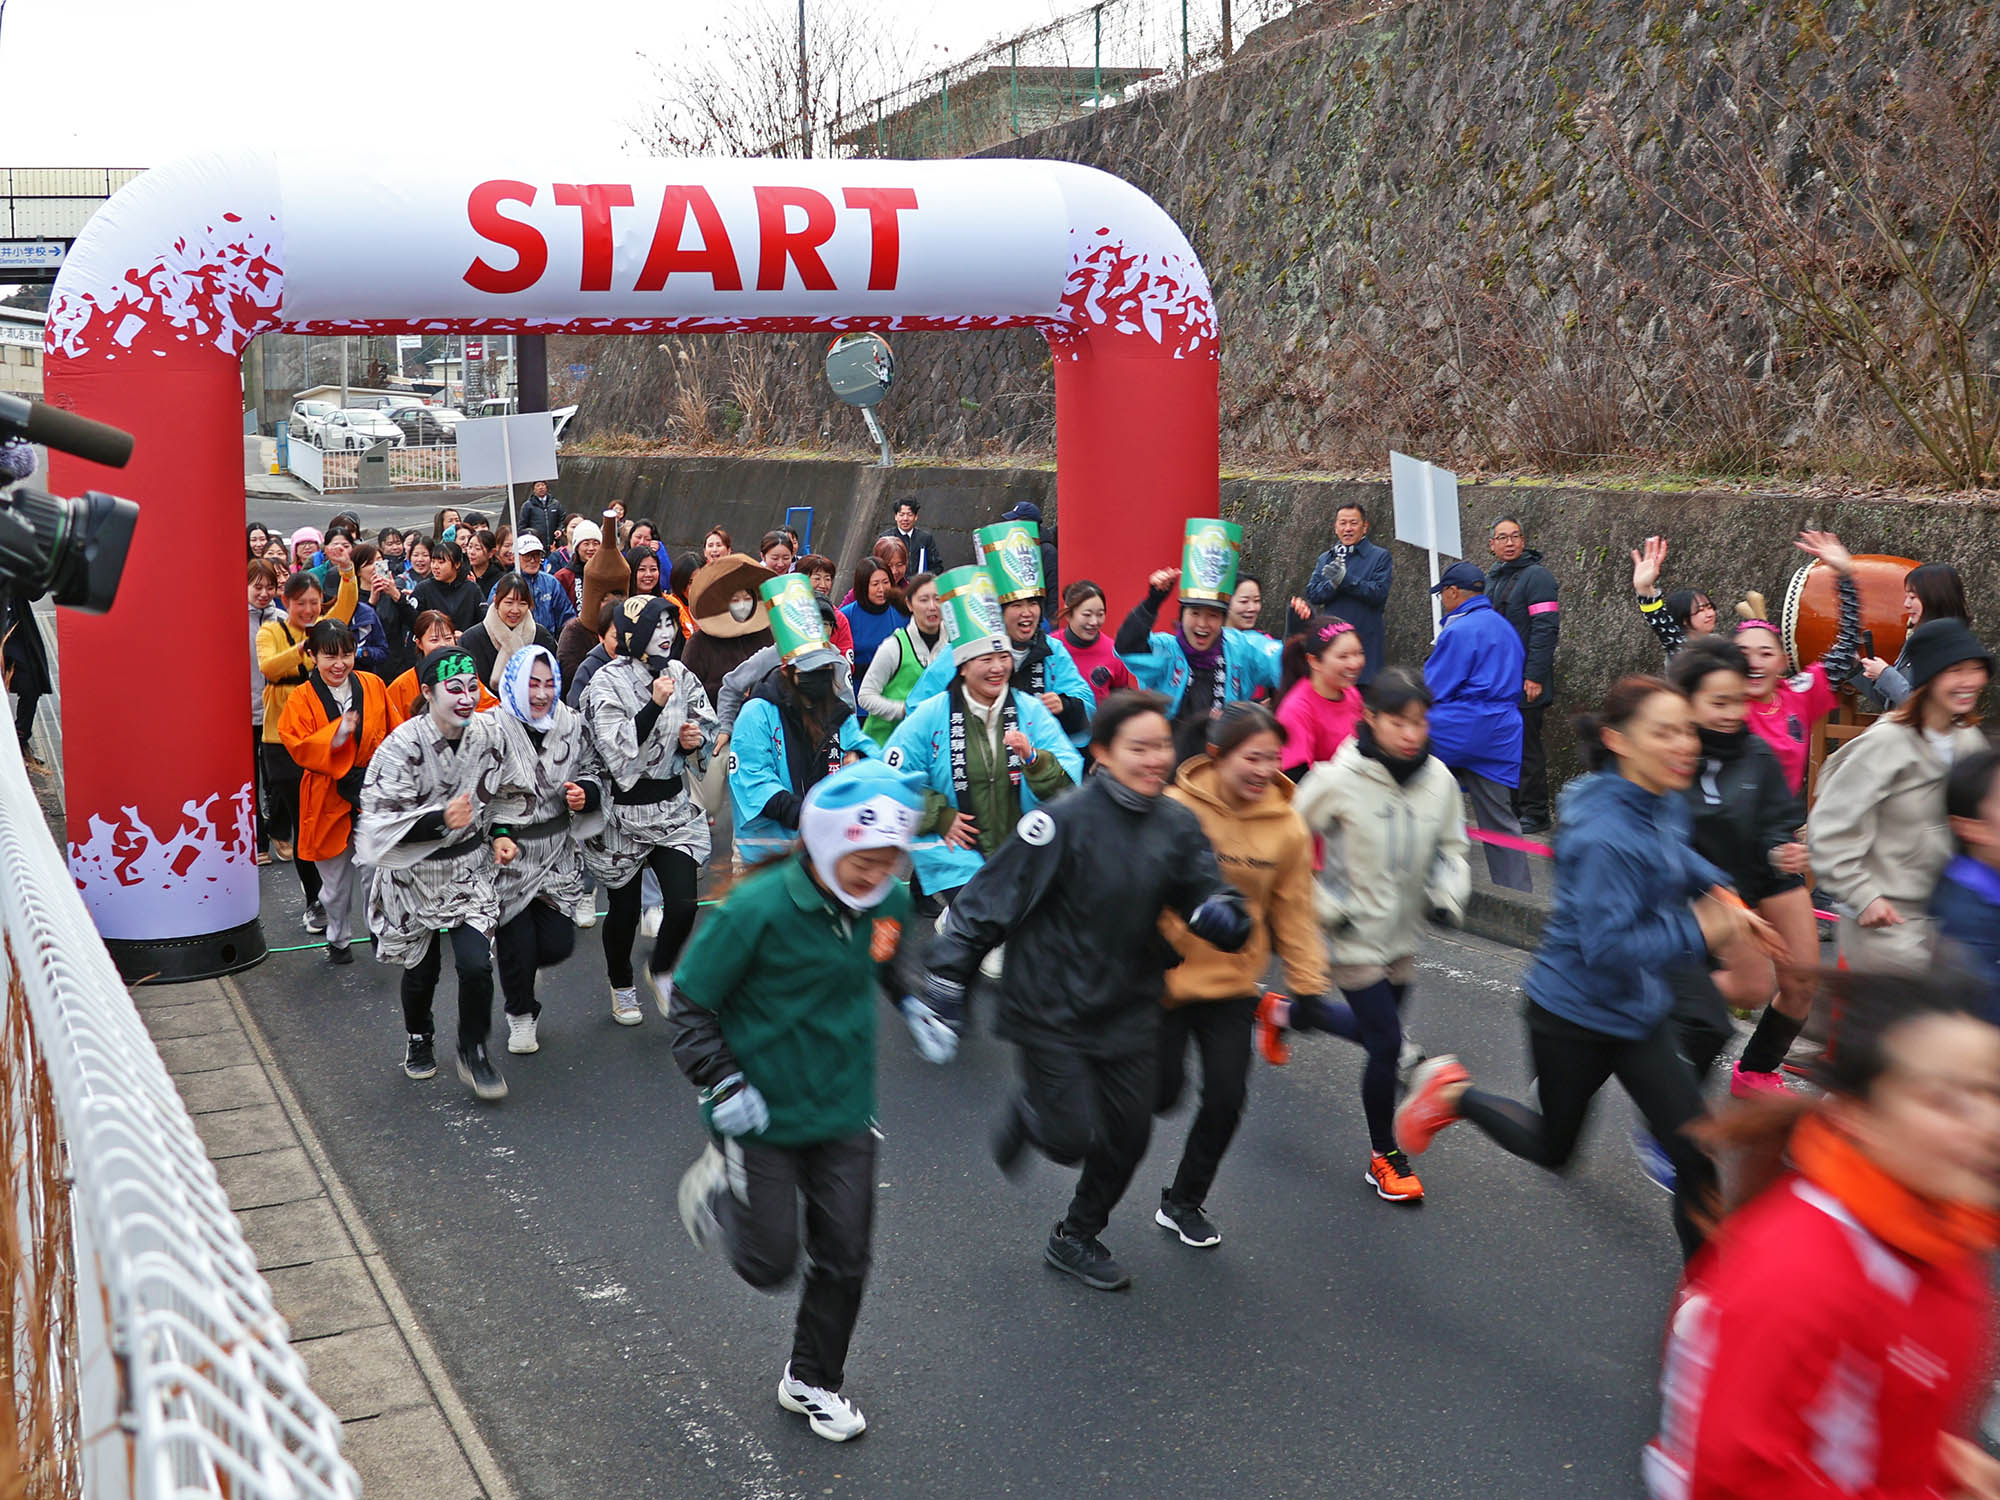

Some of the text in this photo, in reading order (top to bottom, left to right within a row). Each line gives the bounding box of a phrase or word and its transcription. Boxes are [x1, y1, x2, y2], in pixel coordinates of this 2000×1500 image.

[462, 179, 919, 294] START
[729, 756, 737, 769] B
[888, 751, 899, 766] B
